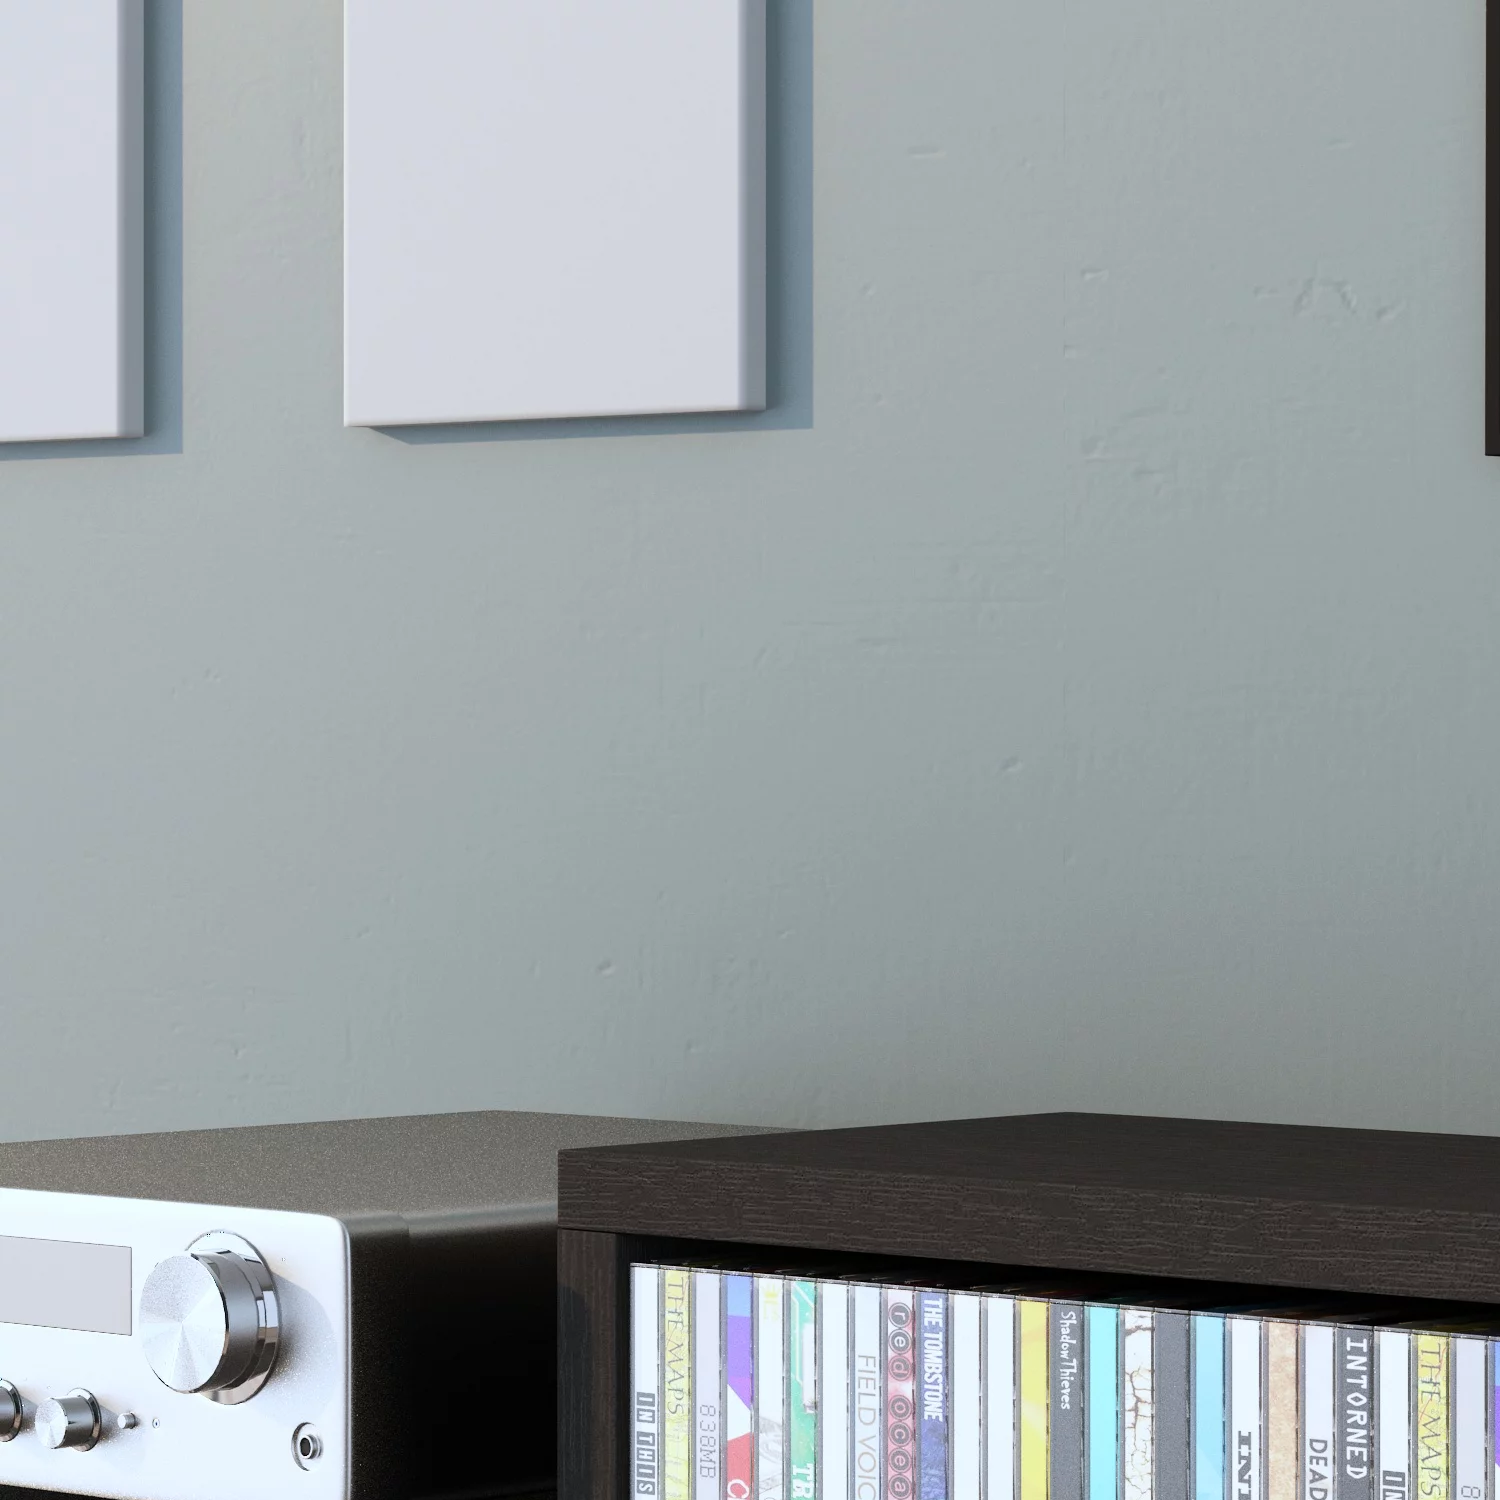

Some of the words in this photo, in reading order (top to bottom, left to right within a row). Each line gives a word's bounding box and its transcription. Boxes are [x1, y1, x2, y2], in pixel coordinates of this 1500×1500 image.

[667, 1277, 684, 1332] THE
[924, 1299, 943, 1327] THE
[667, 1339, 684, 1415] MAPS
[888, 1302, 912, 1381] red
[924, 1331, 943, 1422] TOMBSTONE
[1421, 1343, 1441, 1404] THE
[637, 1392, 655, 1423] IN
[858, 1355, 876, 1426] FIELD
[1346, 1337, 1368, 1479] INTORNED
[636, 1431, 655, 1495] THIS
[700, 1404, 716, 1478] 838MB
[1420, 1413, 1442, 1496] MAPS
